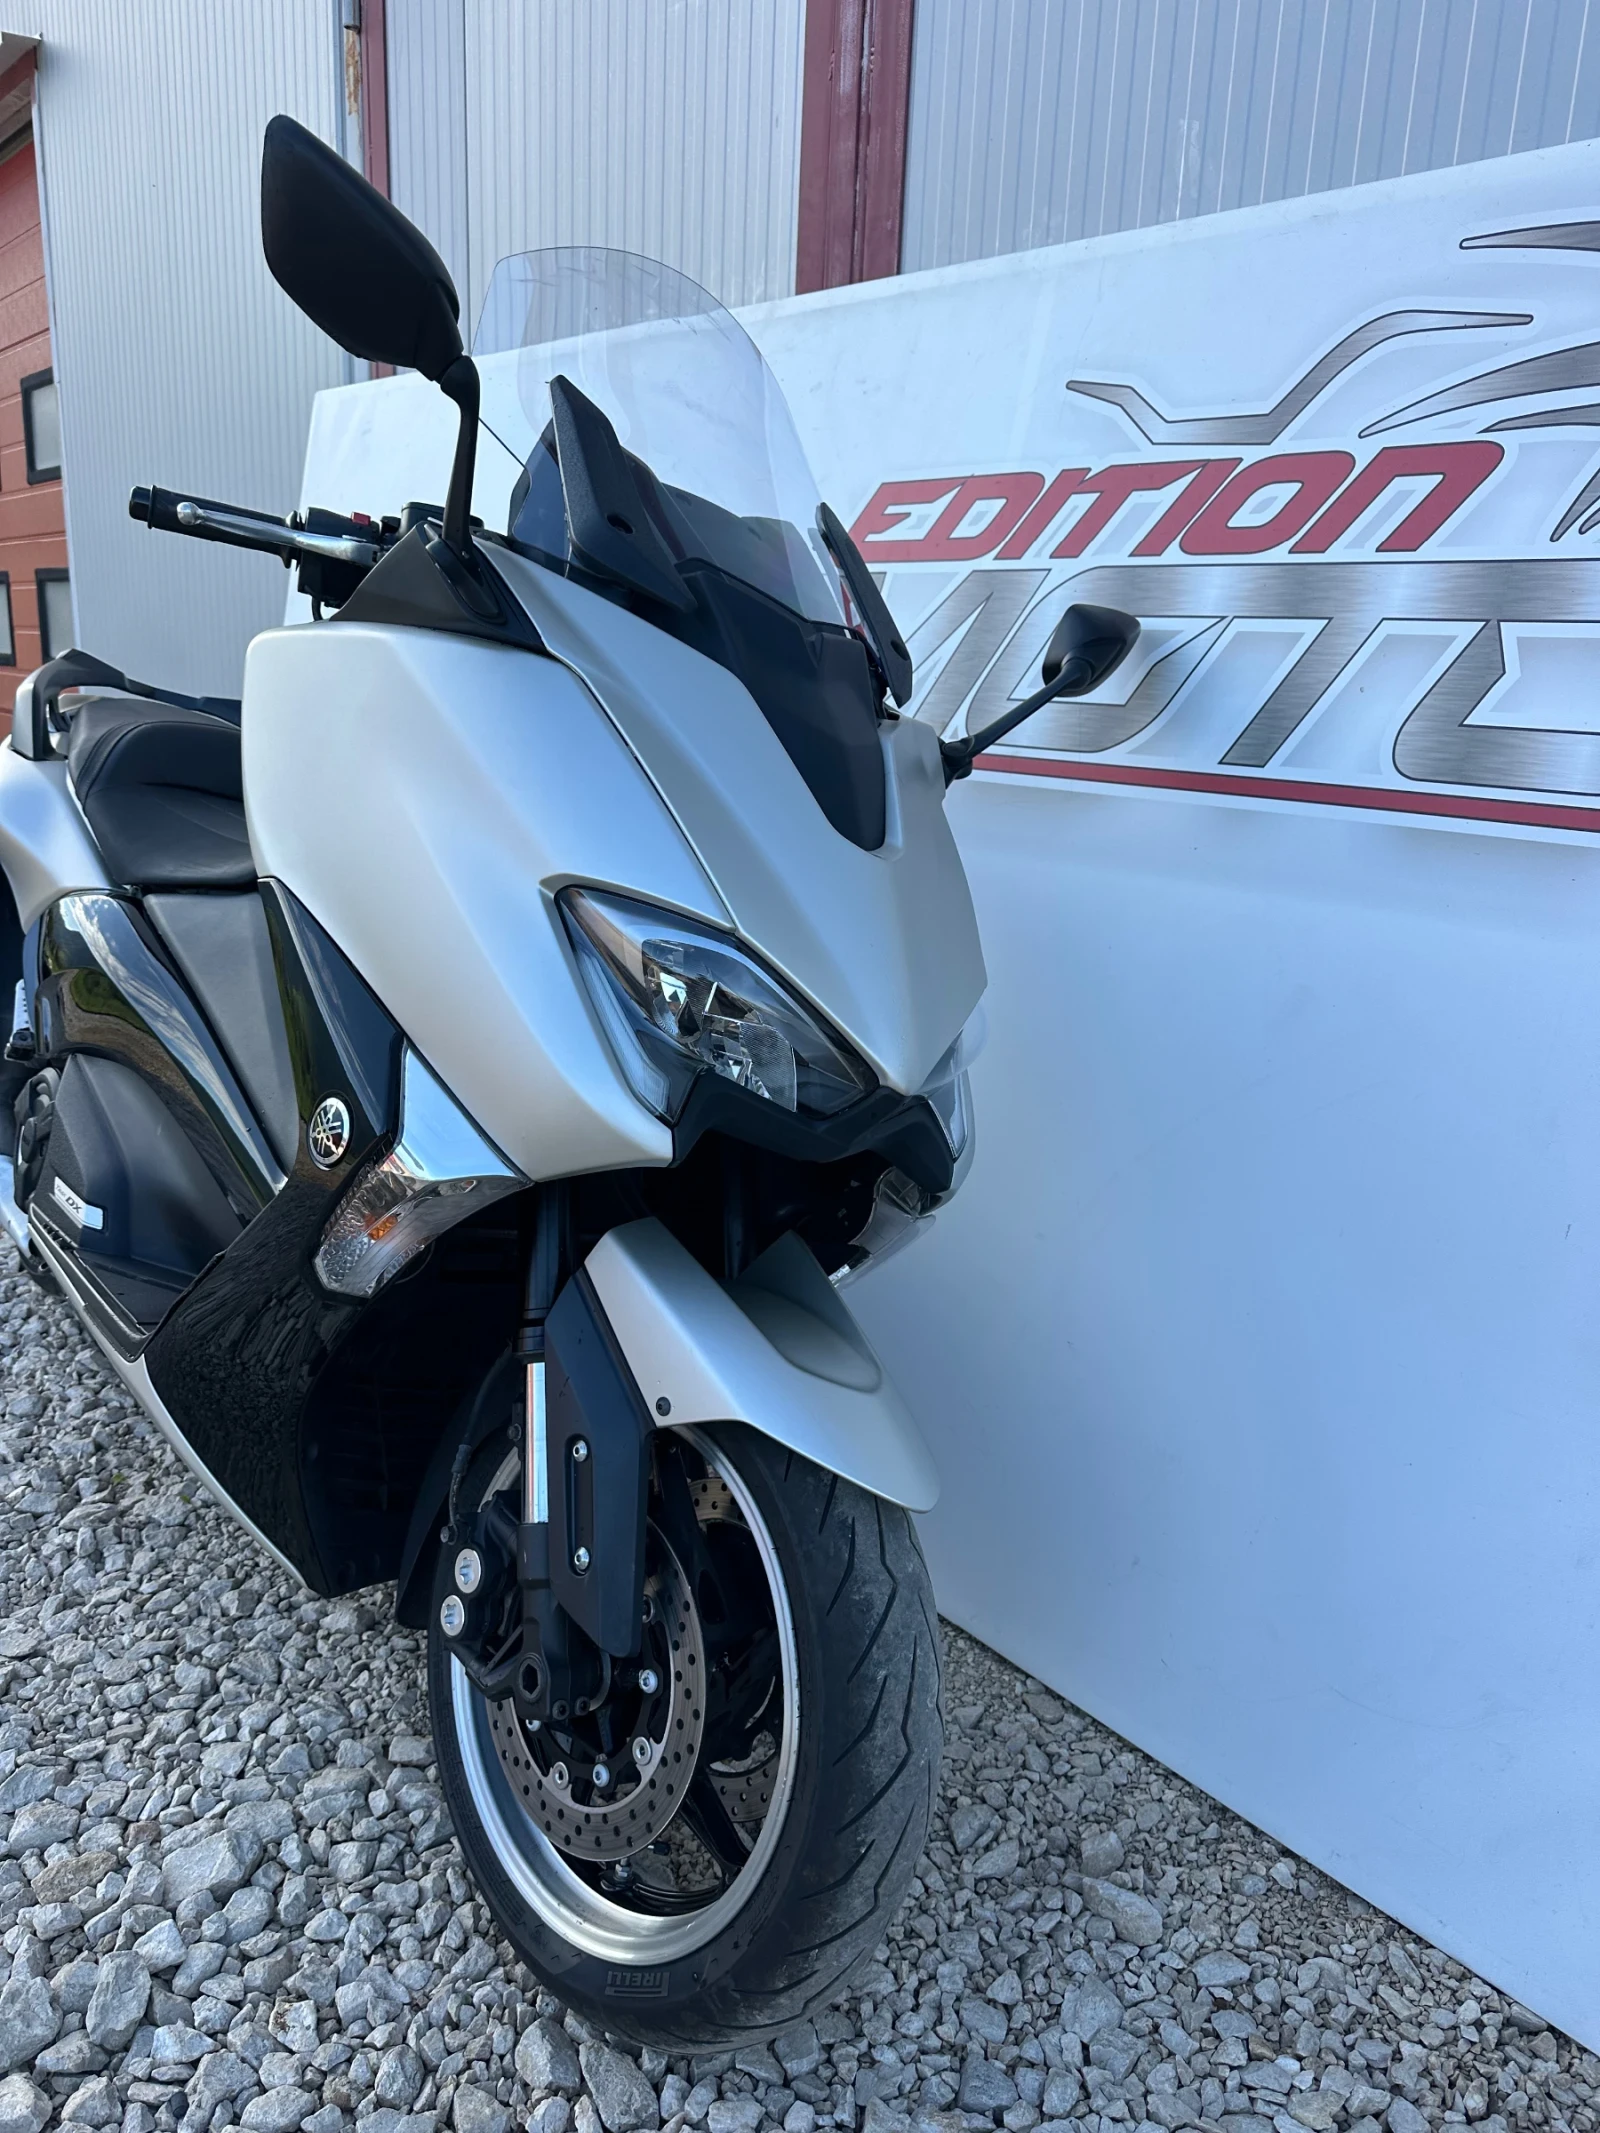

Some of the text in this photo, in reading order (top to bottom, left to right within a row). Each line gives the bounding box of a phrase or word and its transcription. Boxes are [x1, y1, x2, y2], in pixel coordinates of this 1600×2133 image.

[848, 440, 1505, 563] EDITION
[65, 1196, 82, 1214] DX
[604, 1970, 671, 1998] PIRELLI
